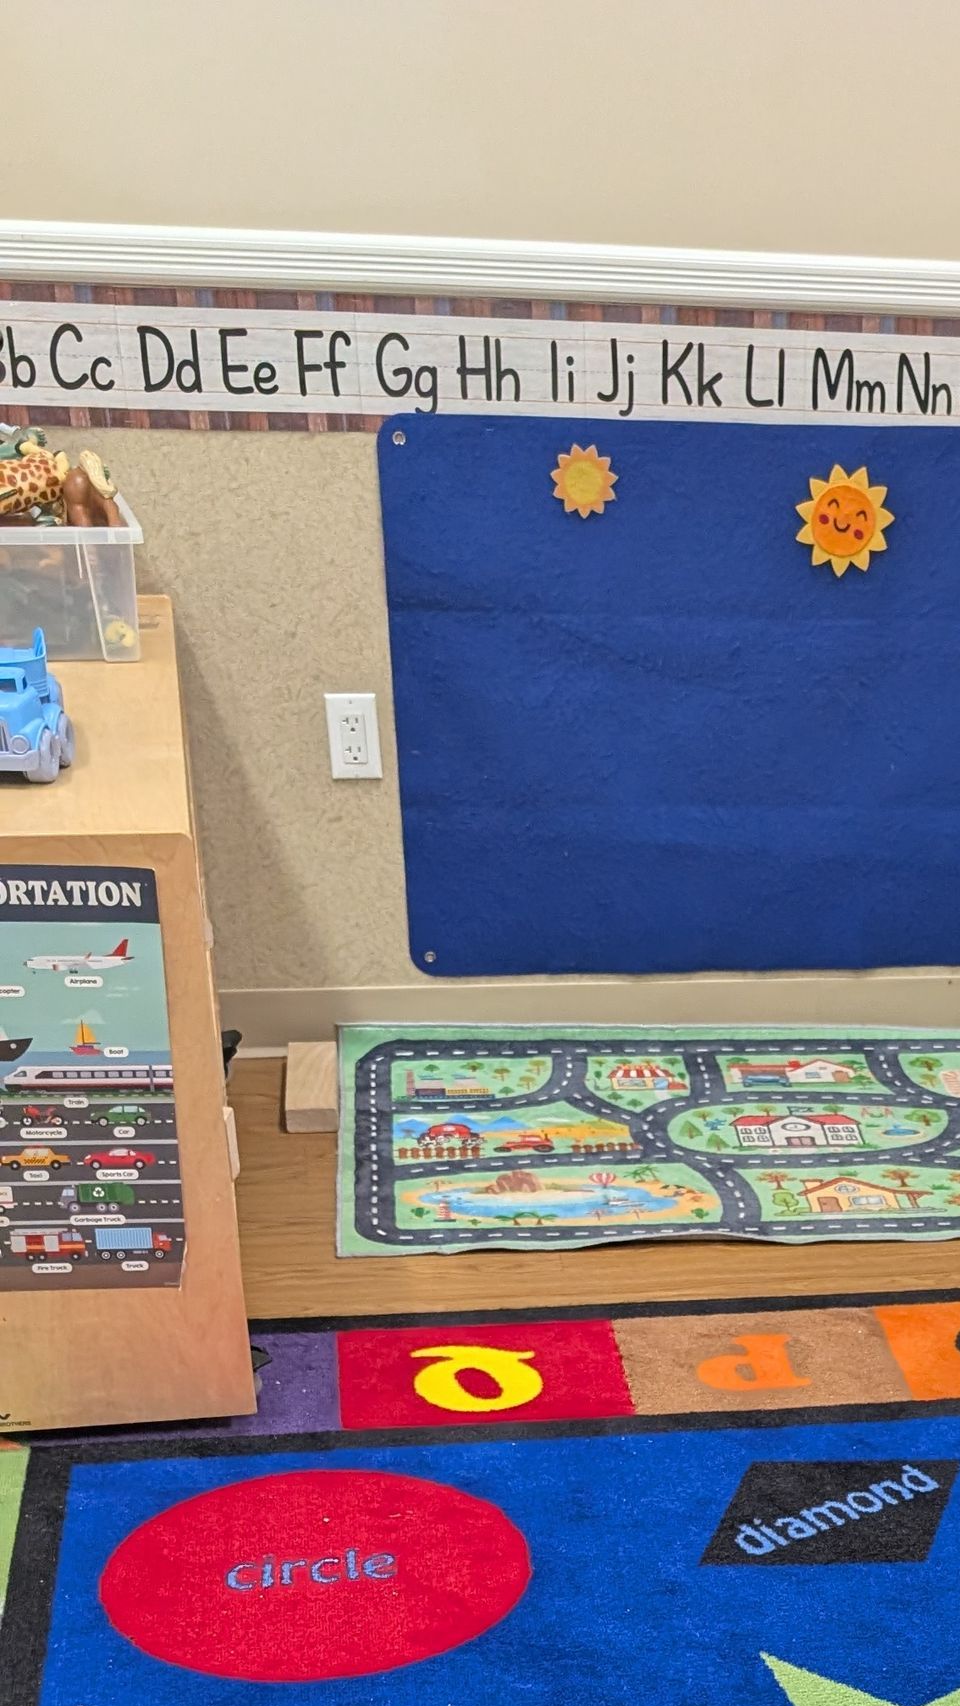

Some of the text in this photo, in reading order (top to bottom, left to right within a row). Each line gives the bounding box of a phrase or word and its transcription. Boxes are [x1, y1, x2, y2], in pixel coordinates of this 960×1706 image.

[0, 326, 36, 389] b
[50, 323, 115, 391] Cc
[137, 326, 203, 393] Dd
[219, 328, 279, 395] Ee
[295, 330, 351, 397] Ff
[376, 333, 438, 413] Gg
[457, 335, 521, 402] Hh
[550, 341, 574, 403] Ii
[597, 339, 635, 417] Jj
[661, 340, 723, 407] Kk
[745, 345, 785, 408] Ll
[812, 348, 886, 414] Mm
[896, 351, 952, 416] Nn
[70, 978, 98, 986] Airplane
[68, 1098, 85, 1106] Train
[25, 1129, 63, 1138] Motorcycle
[118, 1128, 130, 1136] Car
[102, 1171, 122, 1179] Sports
[74, 1216, 103, 1224] Garbage
[126, 1262, 144, 1270] Truck
[696, 1333, 811, 1391] P
[410, 1343, 543, 1411] Q
[735, 1464, 939, 1556] diamond
[227, 1547, 397, 1593] circle
